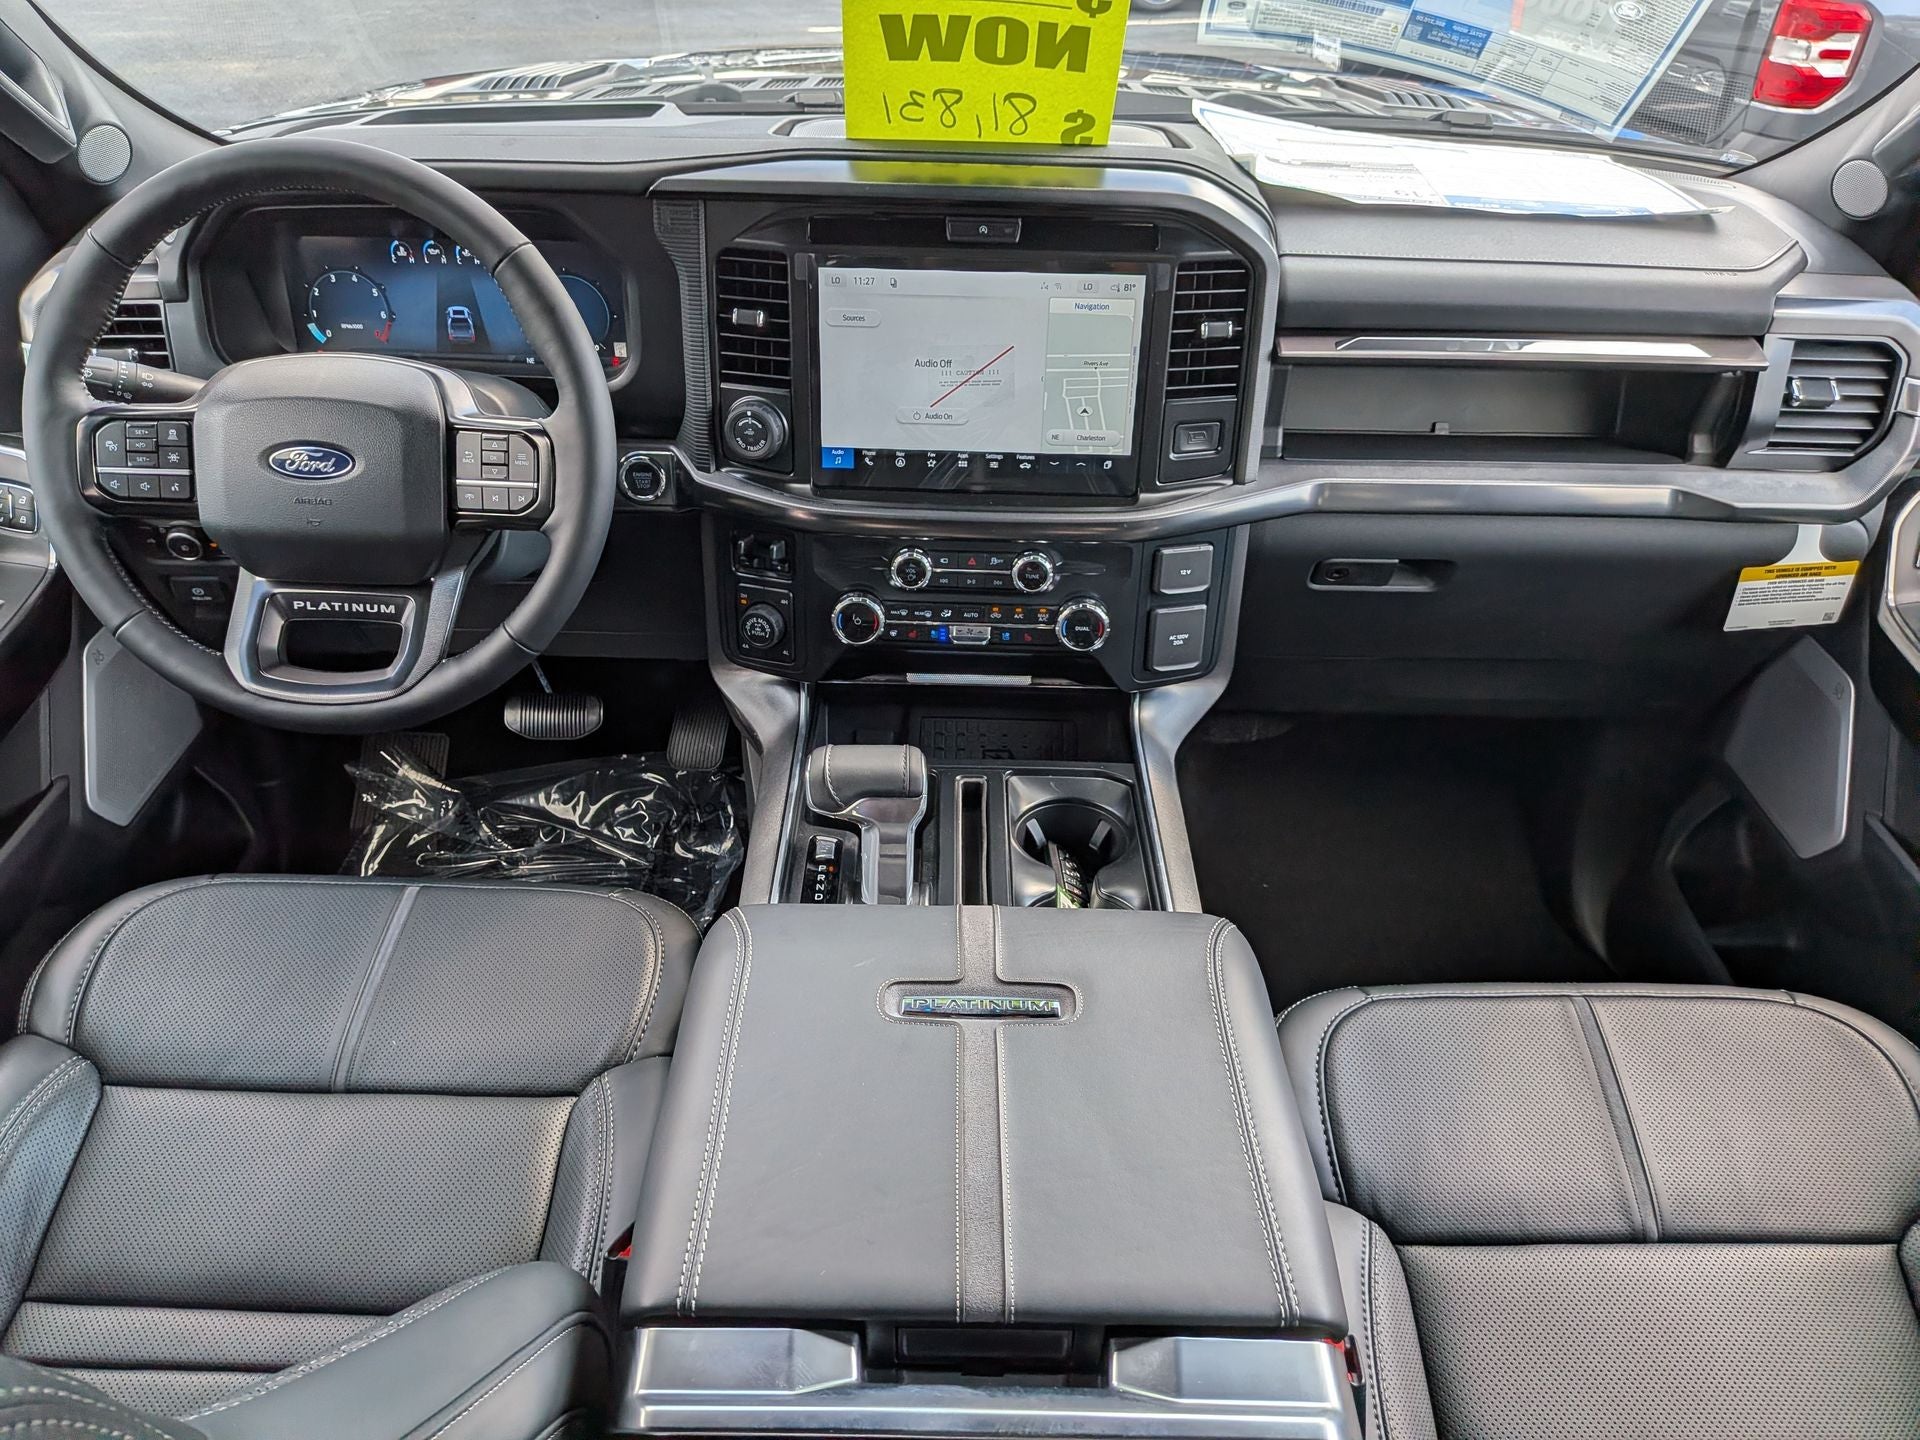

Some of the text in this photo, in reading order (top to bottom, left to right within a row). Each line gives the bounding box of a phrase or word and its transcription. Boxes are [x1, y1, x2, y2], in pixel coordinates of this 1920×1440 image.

[330, 274, 336, 283] 3
[351, 274, 358, 283] 4
[831, 276, 875, 286] LO 11:27
[313, 287, 320, 296] 2
[1123, 282, 1136, 292] 81°
[372, 288, 379, 296] 5
[1074, 302, 1110, 311] Navigation
[380, 310, 387, 319] 6
[842, 314, 866, 322] Sources
[325, 329, 332, 338] 0
[914, 358, 953, 369] Audio Off
[924, 412, 953, 421] Audio On
[1051, 433, 1106, 442] NE Charleston
[736, 437, 767, 451] PRO TRAILER
[285, 450, 336, 473] Ford
[292, 600, 396, 614] PLATINUM
[1014, 612, 1025, 620] A/C
[818, 864, 827, 872] P
[816, 883, 825, 891] N
[814, 893, 824, 901] D
[911, 998, 1051, 1012] PLATINUM
